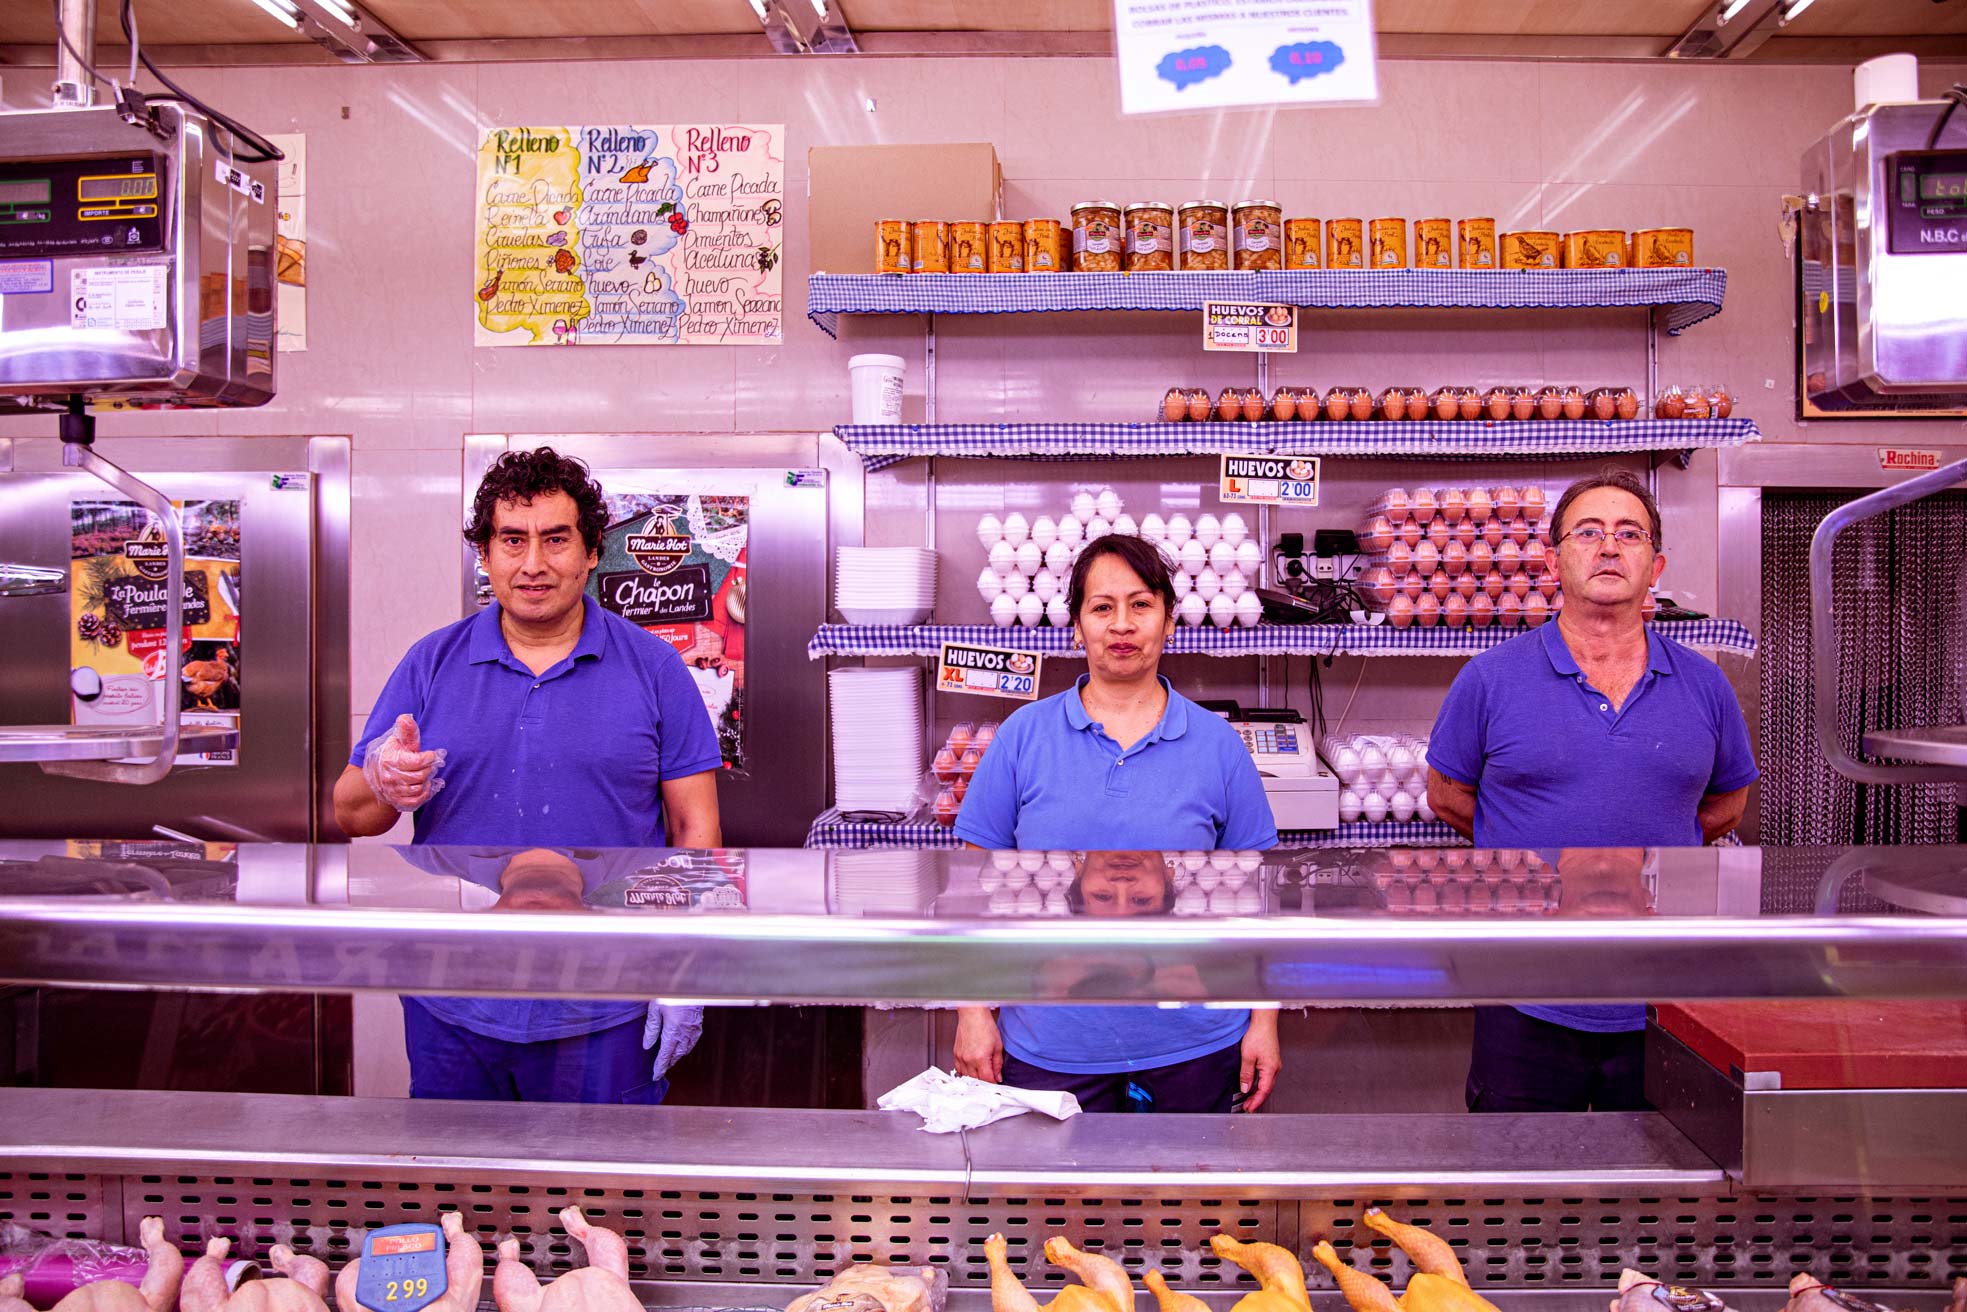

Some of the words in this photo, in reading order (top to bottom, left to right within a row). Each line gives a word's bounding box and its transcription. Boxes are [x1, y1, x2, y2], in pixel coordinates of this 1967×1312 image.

[495, 127, 559, 153] Relleno
[587, 127, 648, 153] Relleno
[687, 127, 751, 153] Relleno
[486, 180, 531, 205] Carne
[531, 179, 579, 213] Picada
[582, 178, 624, 203] Carne
[625, 173, 679, 214] Picada
[686, 175, 727, 199] Carne
[731, 172, 781, 204] Picada
[687, 203, 766, 233] Champiñones
[486, 227, 545, 247] Ciruelas
[578, 226, 629, 256] Trufa
[681, 225, 760, 263] Pimientos
[484, 248, 541, 280] Piñones
[533, 268, 583, 296] Serrano
[684, 272, 748, 294] huevo
[484, 292, 525, 326] Pedro
[589, 294, 627, 320] Jamón
[627, 289, 680, 320] Serrano
[1211, 305, 1264, 316] HUEVOS
[578, 315, 616, 341] Pedro
[679, 313, 722, 339] Pedro
[1211, 315, 1223, 324] DE
[1225, 315, 1262, 325] CORRAL
[1228, 460, 1285, 477] HUEVOS
[1886, 450, 1935, 465] Rochina
[1229, 479, 1241, 493] L
[128, 544, 161, 557] Marie
[630, 538, 665, 551] Marie
[665, 538, 688, 551] Hot
[641, 559, 677, 572] GASTRONOMIE
[111, 586, 125, 601] La
[615, 577, 694, 612] Chapon
[653, 577, 661, 588] le
[622, 603, 653, 618] fermier
[669, 602, 696, 614] Landes
[947, 649, 1005, 670] HUEVOS
[943, 667, 964, 683] XL
